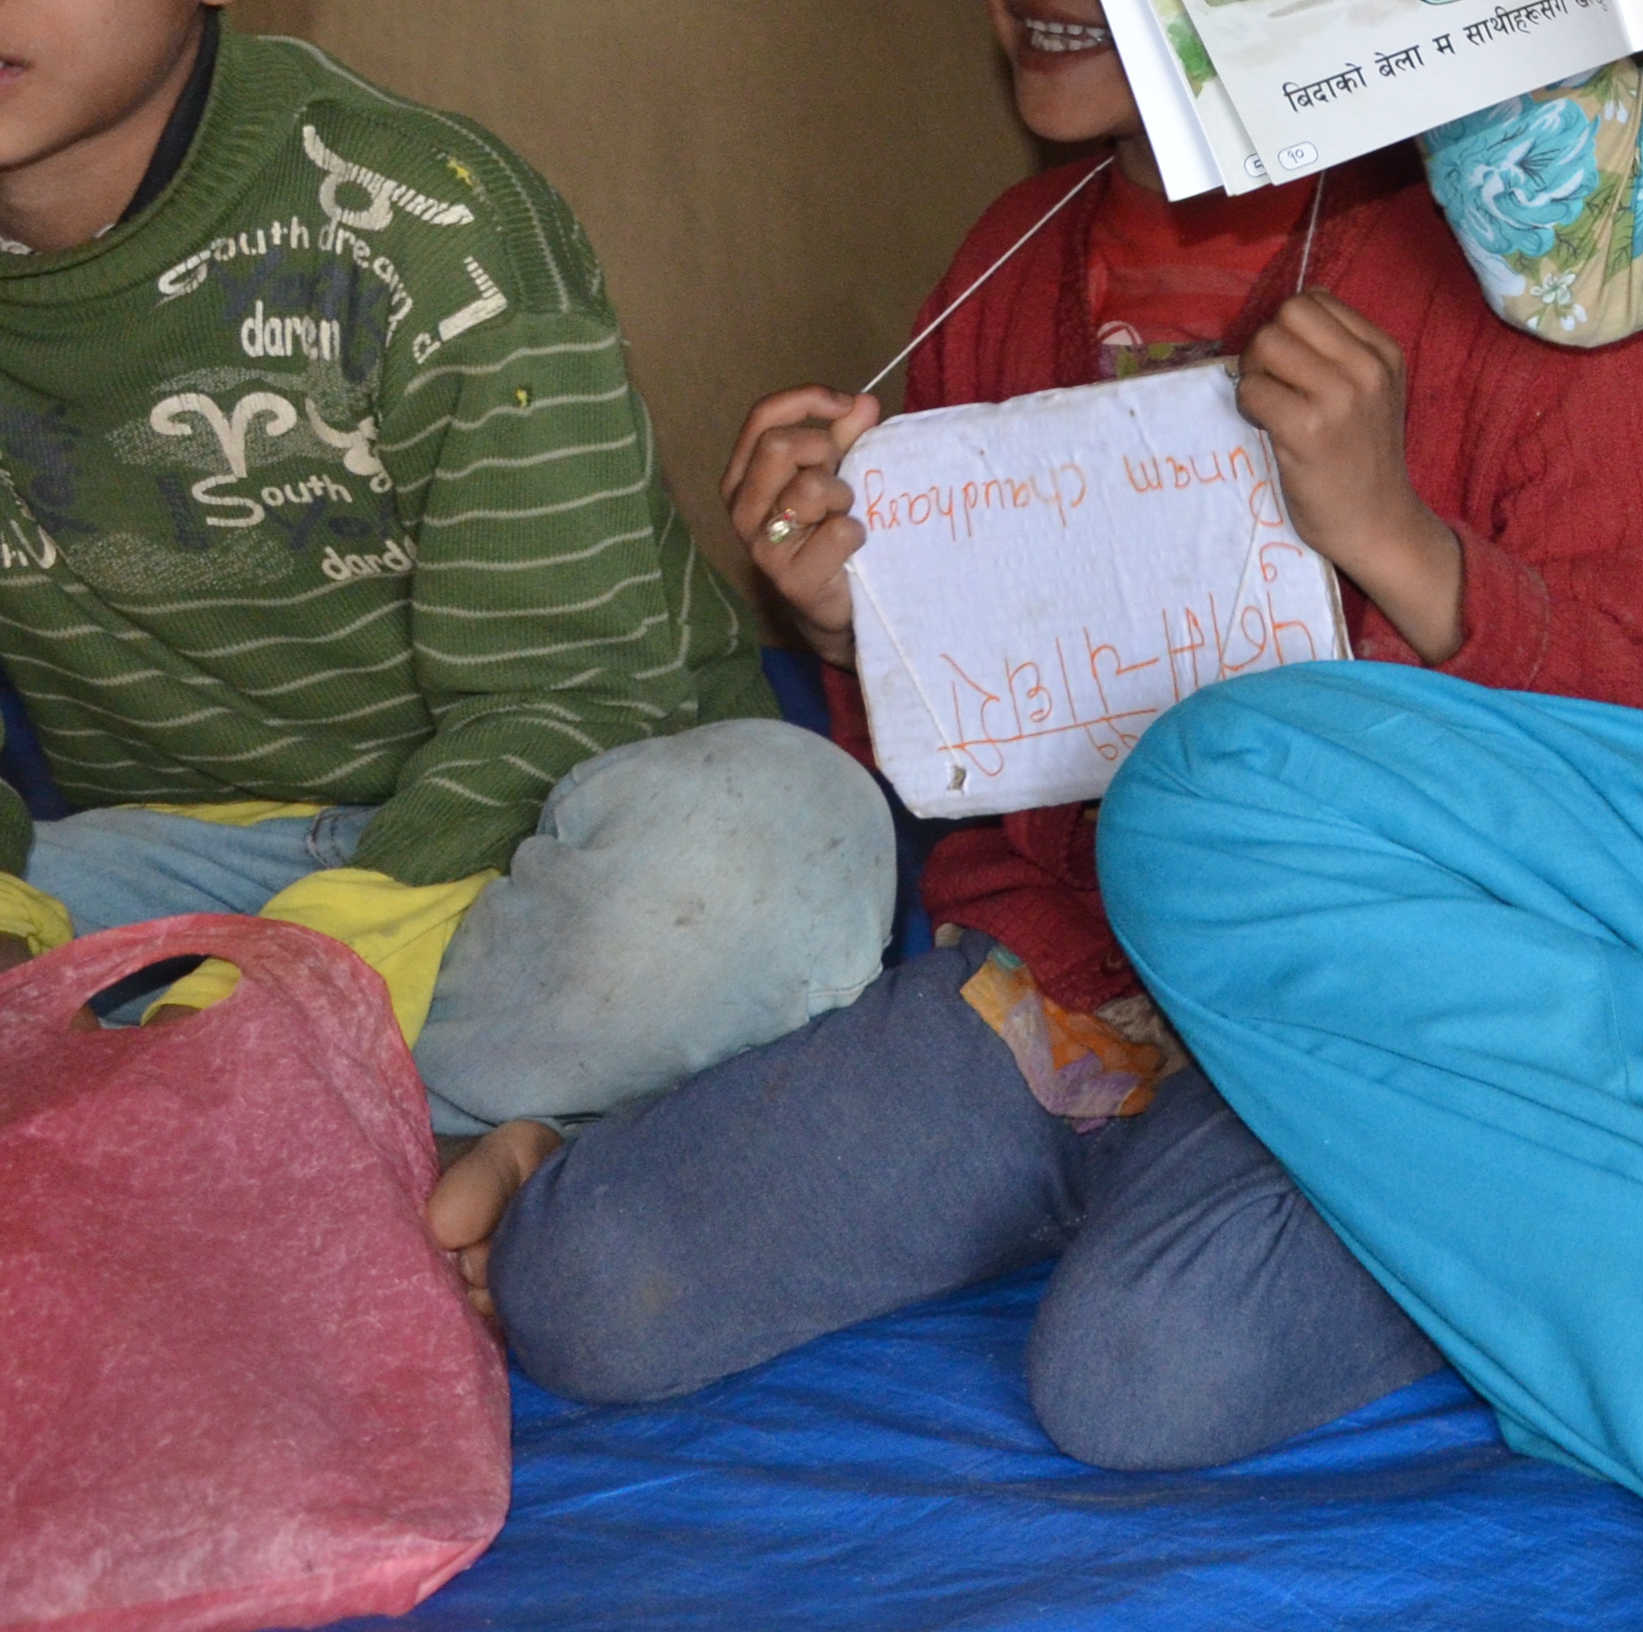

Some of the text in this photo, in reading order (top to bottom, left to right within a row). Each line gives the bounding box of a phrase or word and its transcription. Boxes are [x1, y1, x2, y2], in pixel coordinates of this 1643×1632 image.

[1282, 62, 1368, 113] बिदाको
[1374, 44, 1426, 78] बेला
[1432, 33, 1455, 57] म
